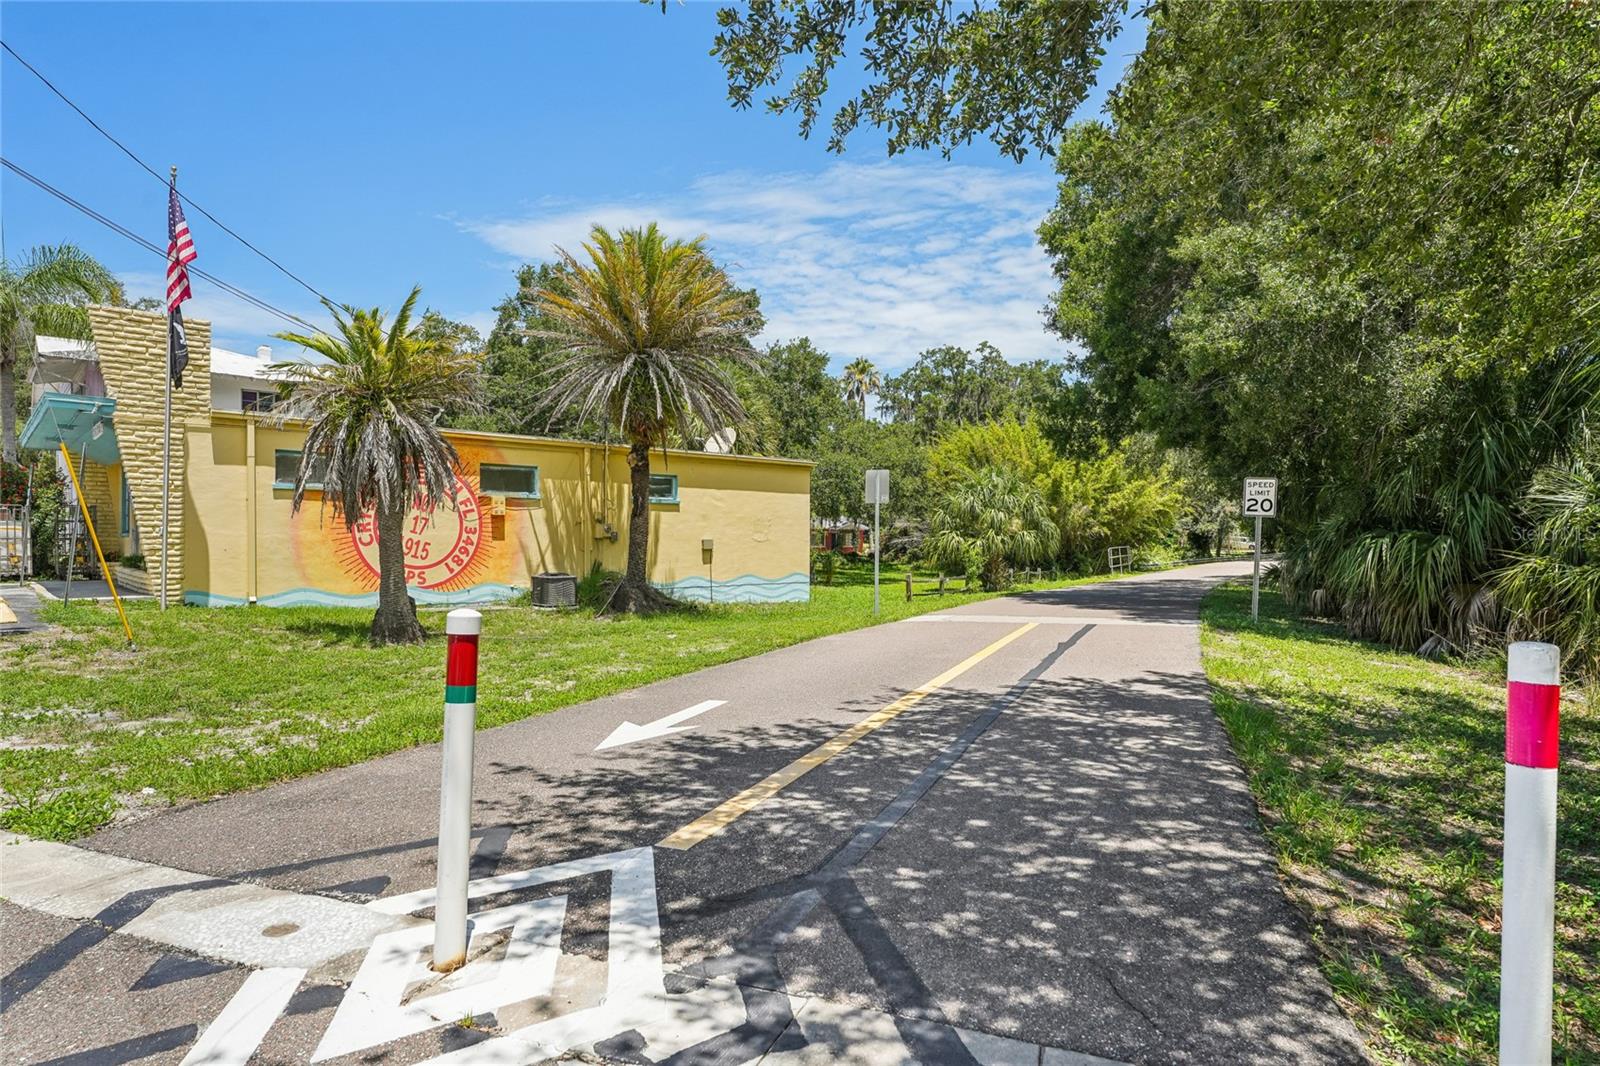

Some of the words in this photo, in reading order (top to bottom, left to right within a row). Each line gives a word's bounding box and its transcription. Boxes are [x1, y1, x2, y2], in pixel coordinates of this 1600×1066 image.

[458, 497, 475, 518] FL
[1246, 498, 1273, 513] 20
[410, 515, 429, 536] 17
[402, 535, 431, 560] 915
[444, 526, 478, 574] 34681
